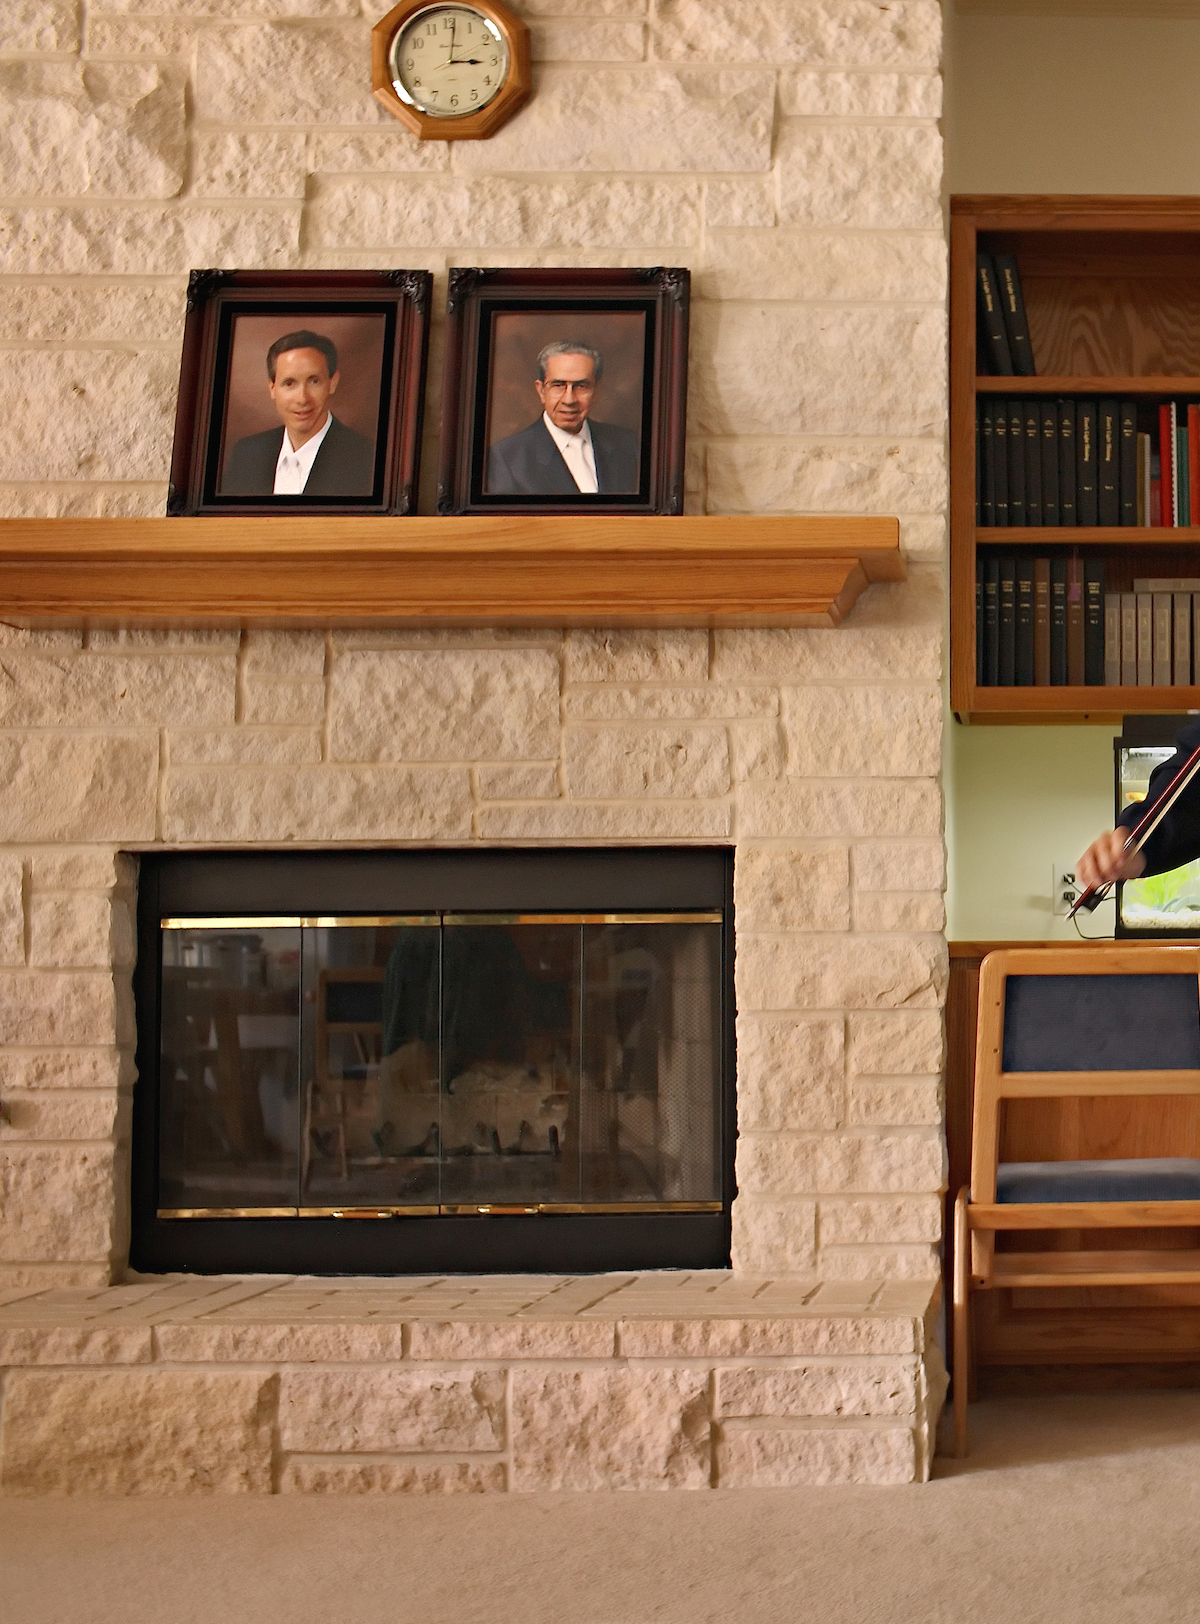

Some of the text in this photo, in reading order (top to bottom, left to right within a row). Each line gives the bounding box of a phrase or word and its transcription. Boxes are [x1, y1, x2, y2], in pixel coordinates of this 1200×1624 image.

[426, 24, 437, 36] 11
[443, 18, 456, 30] 12
[467, 23, 472, 34] 1
[412, 38, 424, 50] 10
[481, 34, 489, 46] 2
[406, 59, 415, 71] 9
[489, 54, 498, 67] 3
[414, 76, 422, 88] 8
[483, 74, 492, 86] 4
[431, 90, 439, 102] 7
[450, 94, 459, 107] 6
[470, 89, 478, 101] 5
